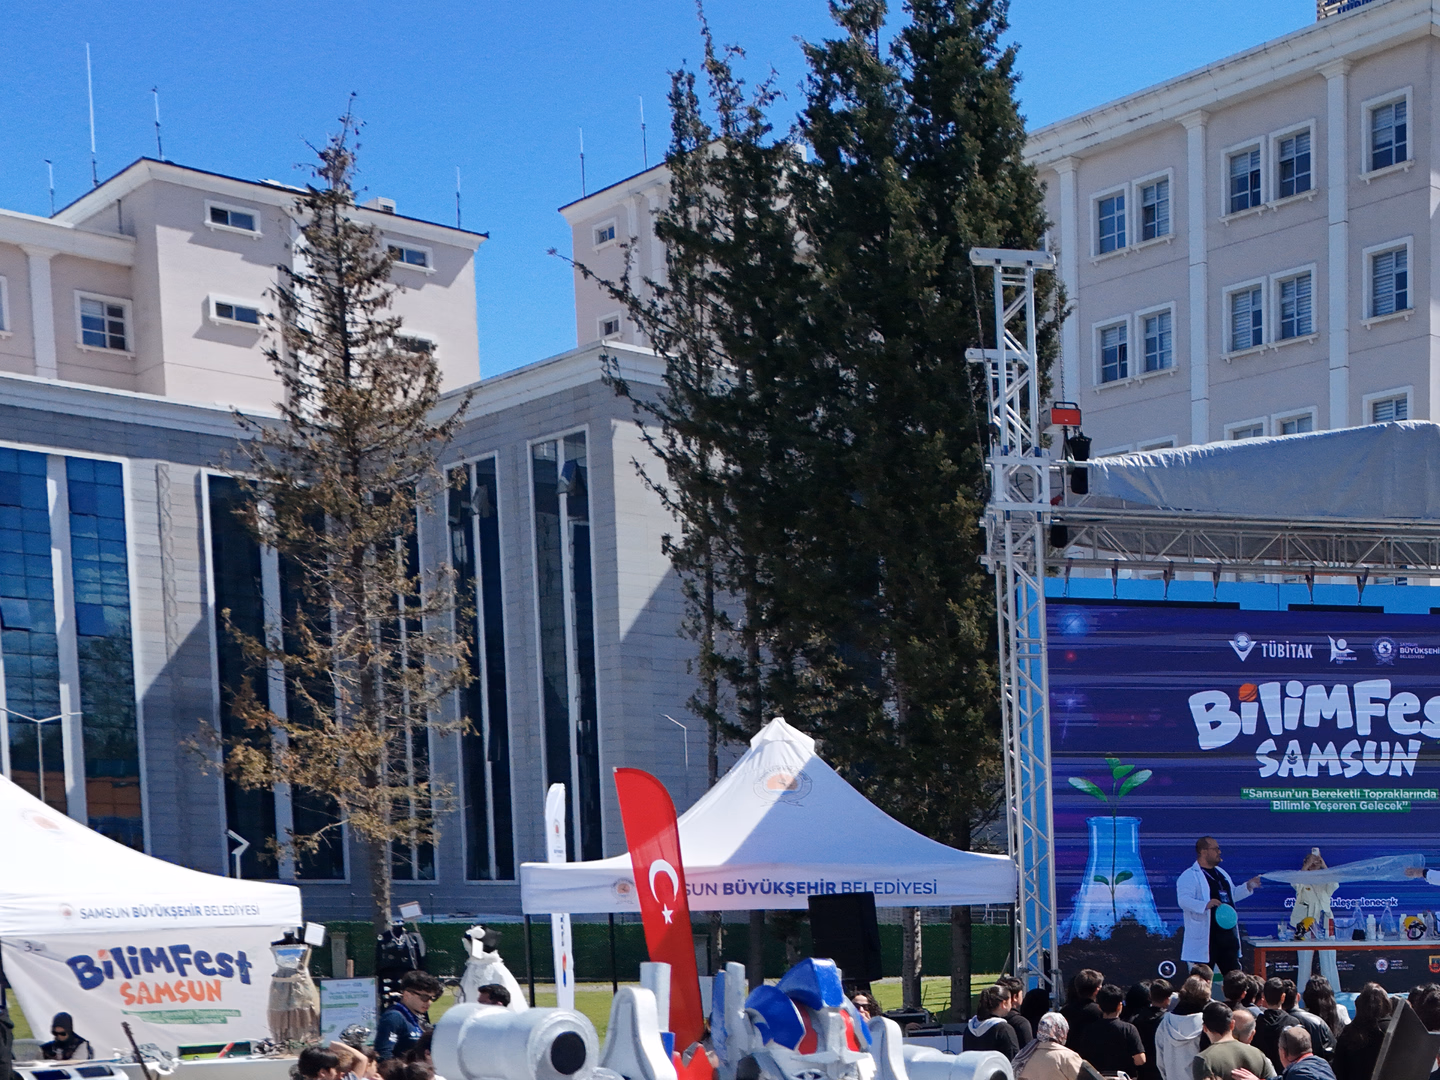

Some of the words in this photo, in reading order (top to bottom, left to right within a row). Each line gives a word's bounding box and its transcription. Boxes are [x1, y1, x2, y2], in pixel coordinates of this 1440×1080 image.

[1261, 640, 1313, 659] TÜBİTAK
[1255, 738, 1423, 779] SAMSUN
[1311, 789, 1360, 799] Bereketli
[1363, 789, 1437, 801] Topraklarında
[1273, 800, 1311, 811] Bilimle
[1313, 801, 1357, 812] Yeşeren
[684, 881, 718, 897] SUN
[722, 878, 837, 898] BÜYÜKŞEHİR
[841, 878, 938, 896] BELEDİYESİ
[80, 907, 130, 920] SAMSUN
[132, 903, 202, 920] BÜYÜKŞEHİR
[204, 902, 260, 917] BELEDİYESİ
[119, 979, 222, 1006] SAMSUN
